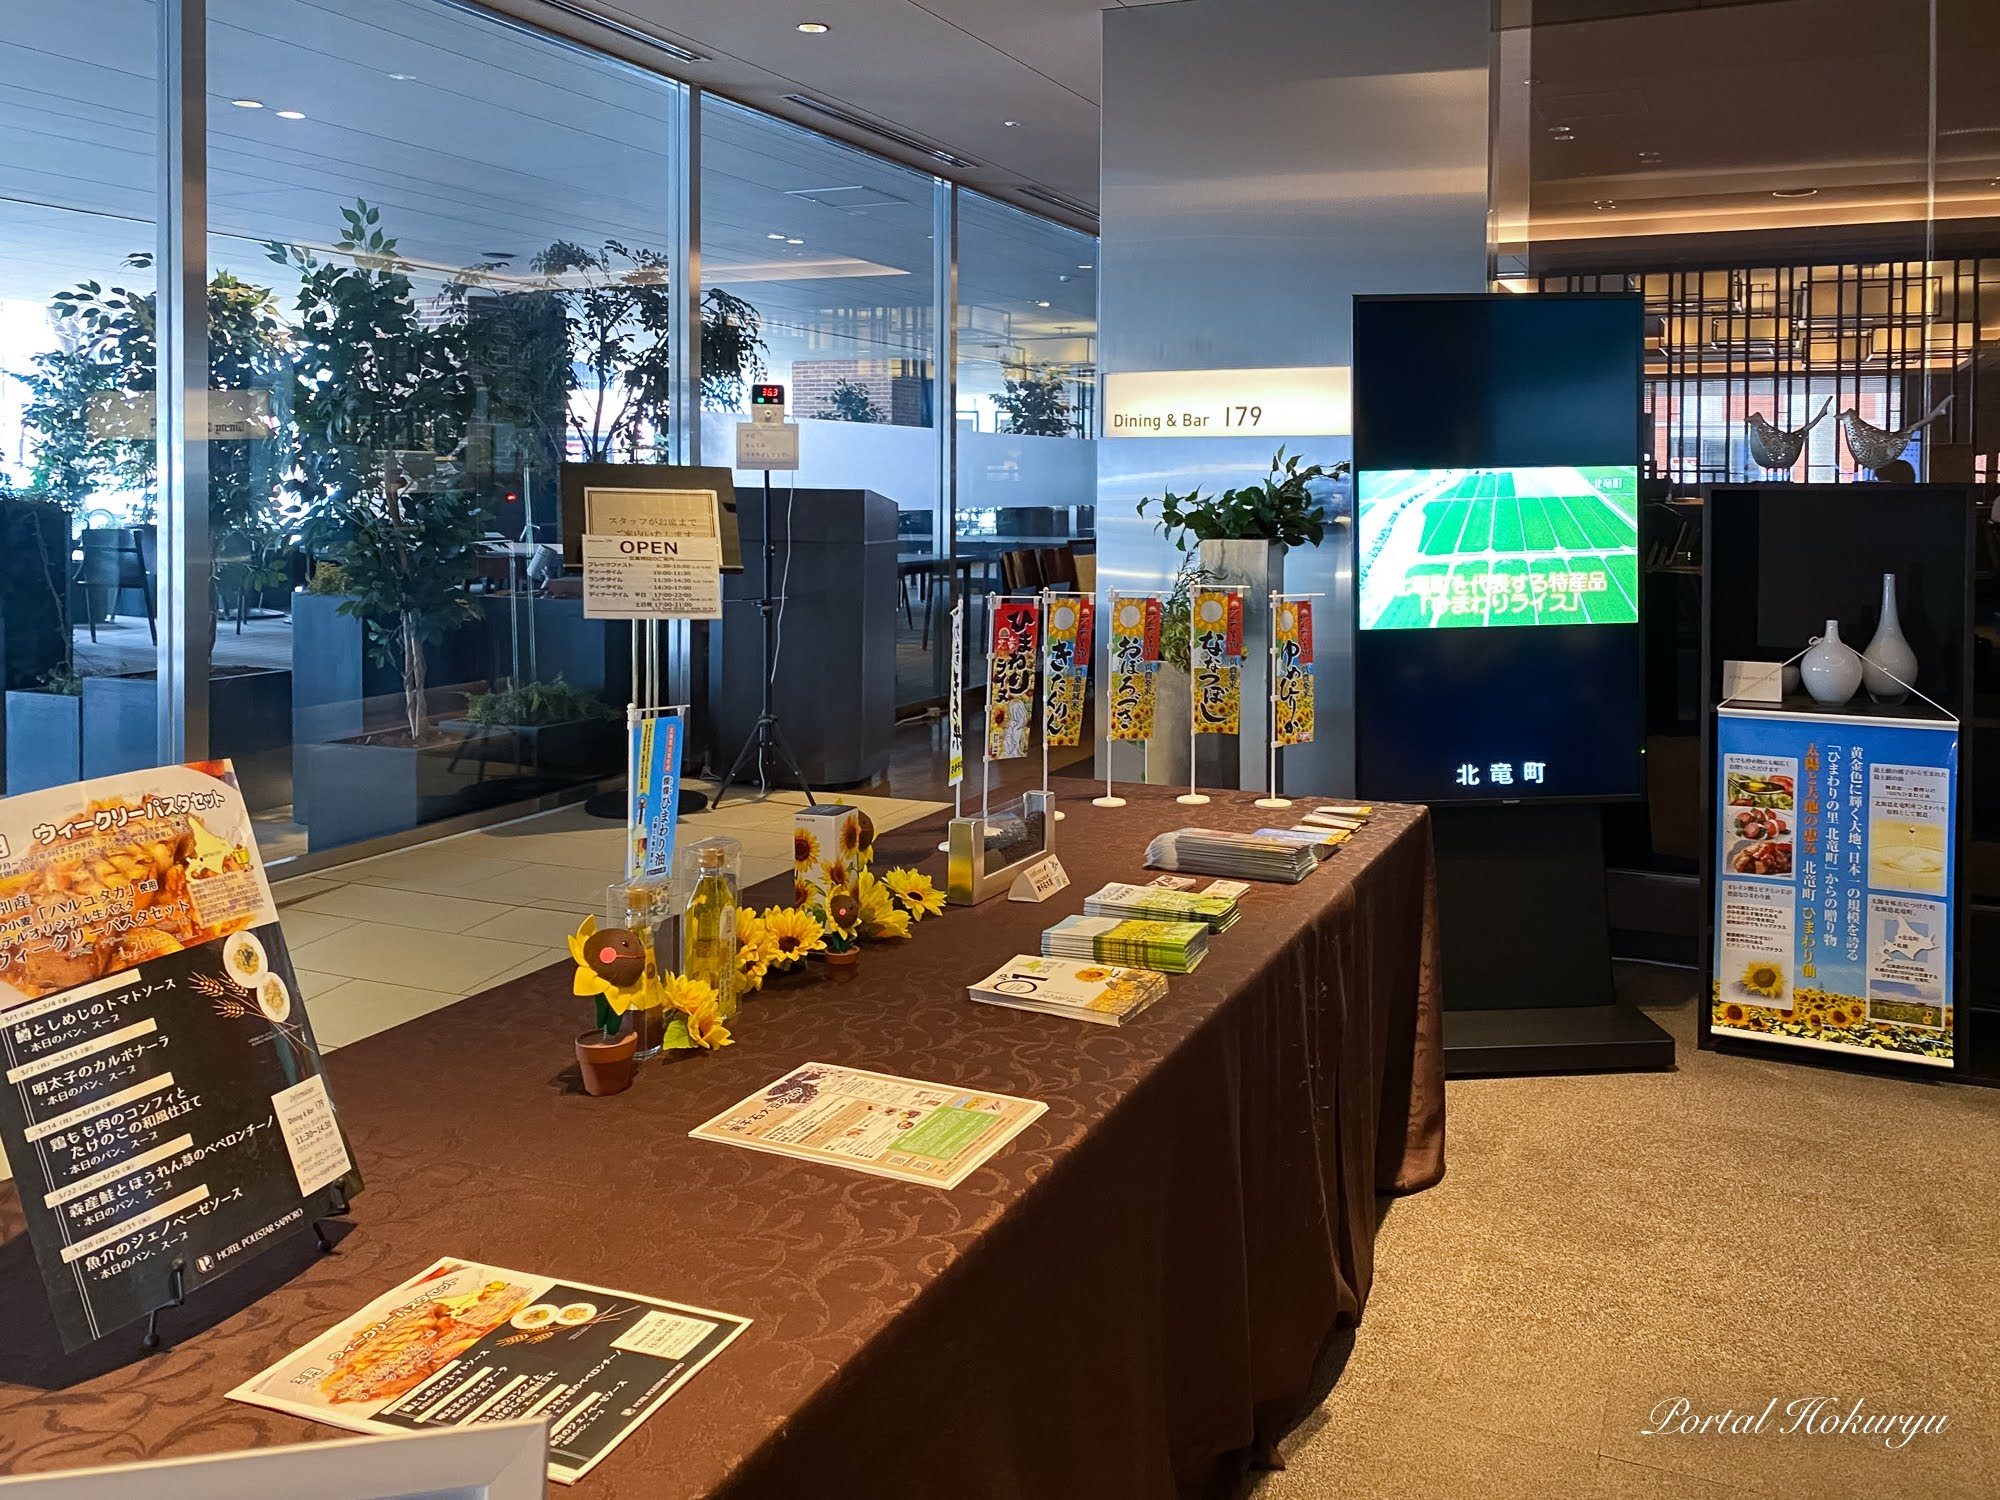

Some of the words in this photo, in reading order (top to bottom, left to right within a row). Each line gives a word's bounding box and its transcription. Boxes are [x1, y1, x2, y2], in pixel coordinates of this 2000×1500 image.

[1114, 414, 1160, 430] Dining
[1166, 414, 1177, 427] &
[1183, 413, 1210, 427] Bar
[1226, 406, 1262, 427] 179
[620, 540, 678, 554] OPEN
[1007, 610, 1036, 696] ひまわり
[1117, 636, 1144, 730] おぼろづき
[1199, 630, 1229, 724] ななつぼし
[1048, 638, 1072, 736] きたくりん
[1280, 640, 1301, 734] ゆめぴりか
[33, 790, 226, 846] ウィークリーパスタセット
[1802, 860, 1817, 902] 北竜町
[0, 900, 135, 949] テルオリジナル生パスタ
[31, 1035, 170, 1096] 明太子のカルボナーラ
[49, 1087, 188, 1152] 鶏もも肉のコンフィと
[70, 1095, 202, 1160] たけのこの和風仕立て
[84, 1187, 243, 1272] 魚介のジェノベーゼソース
[216, 1242, 242, 1260] HOTEL
[241, 1224, 276, 1248] POLESTAR
[290, 1366, 324, 1386] 3月
[327, 1277, 459, 1361] ウィークリーパスタセット
